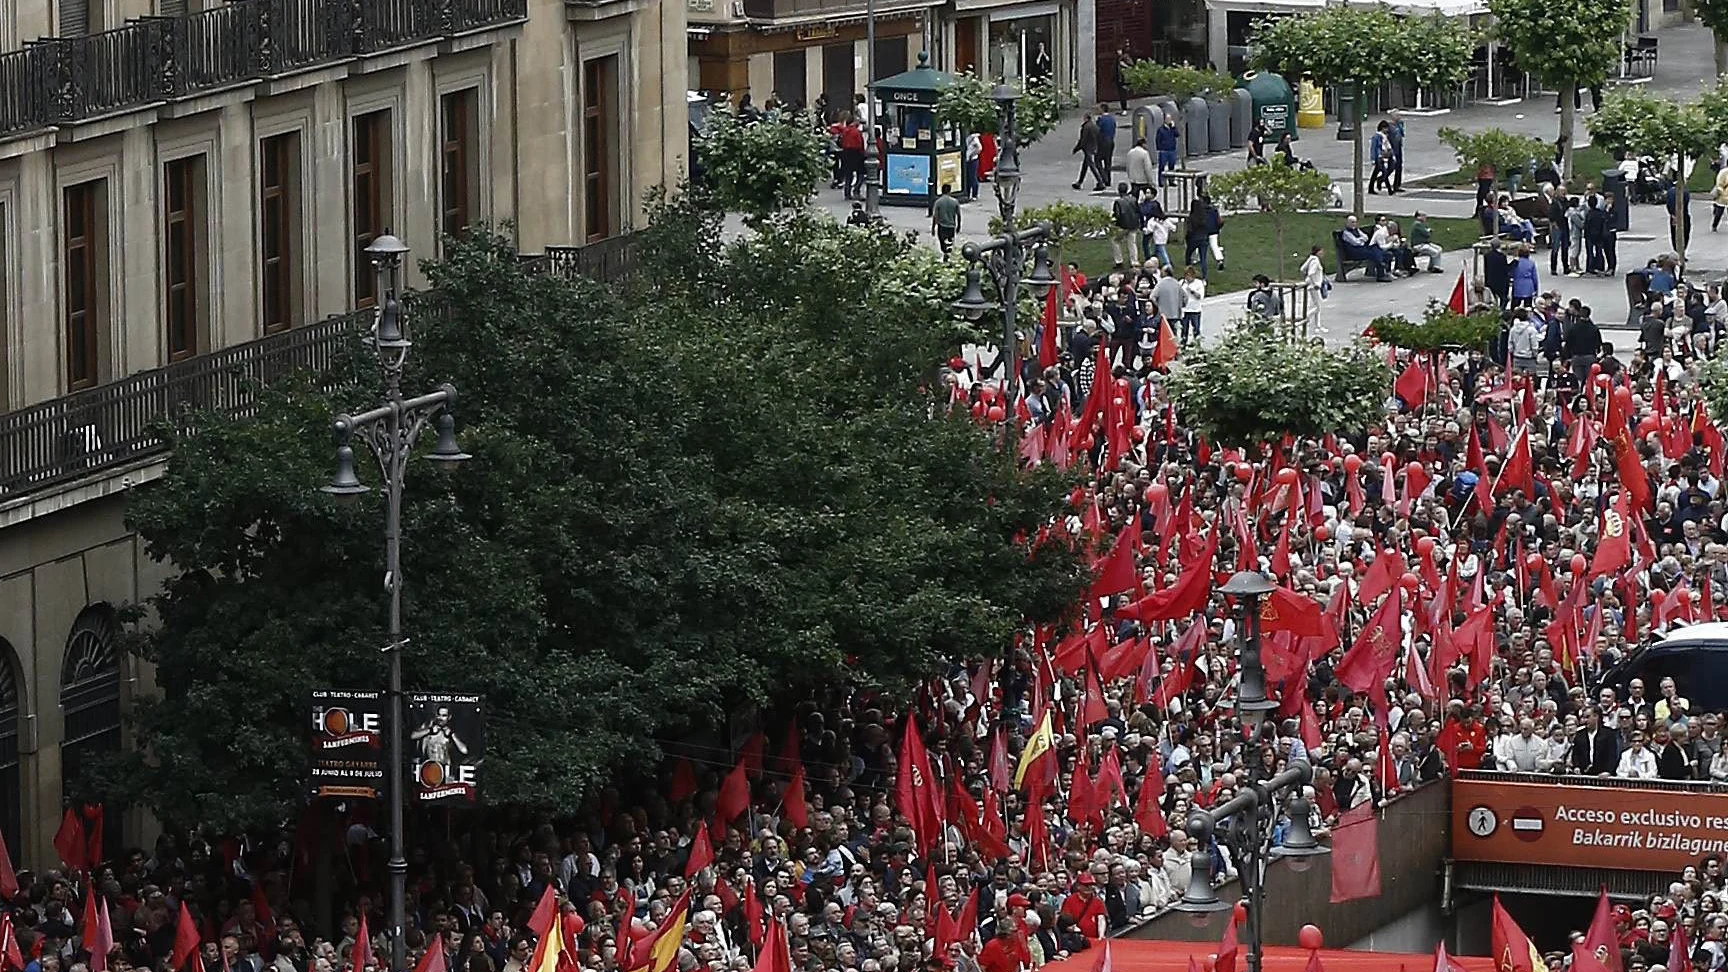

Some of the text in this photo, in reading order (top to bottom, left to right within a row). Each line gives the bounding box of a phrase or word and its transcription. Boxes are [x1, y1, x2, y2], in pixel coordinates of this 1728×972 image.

[894, 92, 918, 101] ONCE
[312, 707, 380, 737] HOLE
[1555, 805, 1616, 823] Acceso
[1620, 808, 1701, 828] exclusivo
[1572, 828, 1642, 848] Bakarrik
